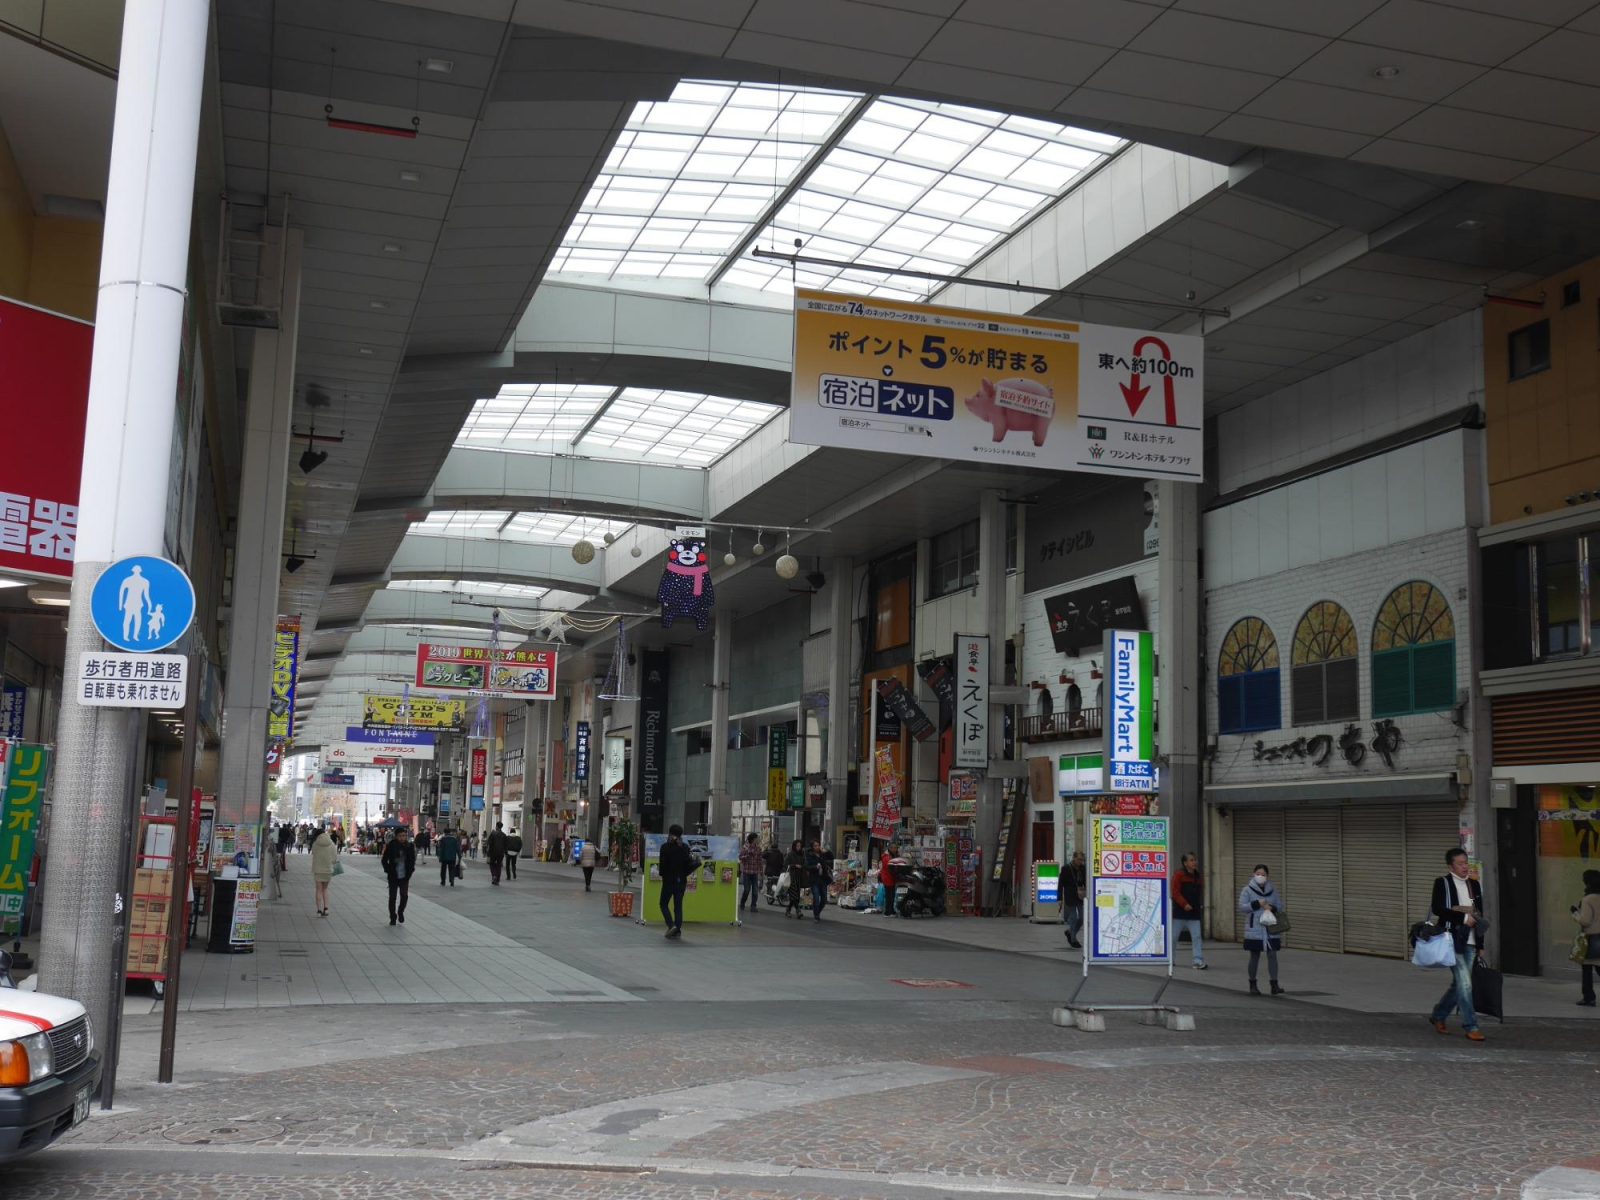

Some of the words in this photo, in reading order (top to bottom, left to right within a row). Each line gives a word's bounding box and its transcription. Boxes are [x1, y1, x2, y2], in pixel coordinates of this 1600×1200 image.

[829, 331, 1048, 374] ポイント5%が貯まる
[1099, 353, 1194, 378] 東へ約100m
[823, 378, 950, 416] 宿泊ネット
[841, 418, 871, 428] 宿泊ネット
[1124, 431, 1176, 445] R&Bホテル
[1110, 449, 1191, 465] ワシントンホテルプラザ
[85, 659, 182, 679] 歩行者用道路
[83, 682, 181, 701] 自転車も乗れません
[1118, 638, 1135, 754] FamilyMart
[382, 702, 446, 712] GOLD'S
[393, 711, 434, 719] GYM
[962, 679, 984, 746] えくぼ
[384, 746, 416, 754] アデランス
[646, 710, 661, 773] Richmond
[1115, 762, 1126, 775] 酒
[1128, 763, 1149, 775] たばこ
[643, 773, 659, 806] Hotel
[1114, 778, 1150, 789] 銀行ATM
[0, 750, 42, 890] リフォーム
[1123, 853, 1165, 862] 自転車
